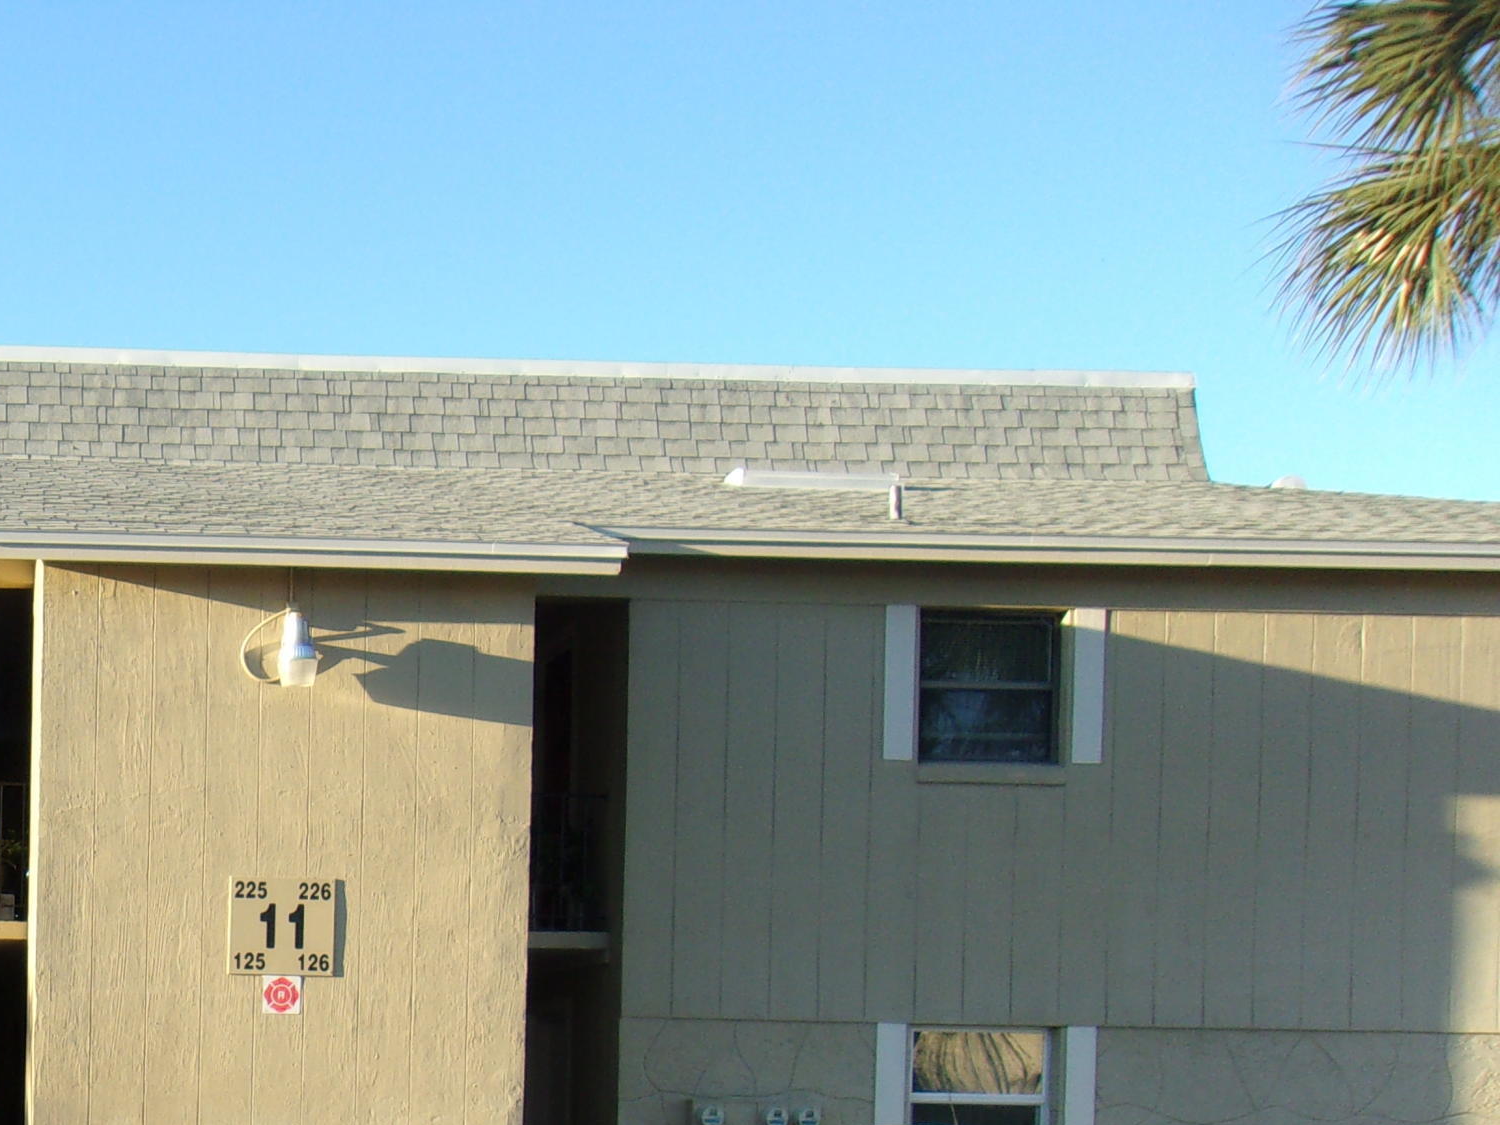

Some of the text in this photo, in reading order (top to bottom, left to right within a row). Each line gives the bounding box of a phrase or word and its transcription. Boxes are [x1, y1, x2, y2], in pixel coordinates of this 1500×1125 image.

[234, 881, 332, 900] 225 226
[260, 903, 305, 949] 11
[234, 952, 329, 971] 125 126
